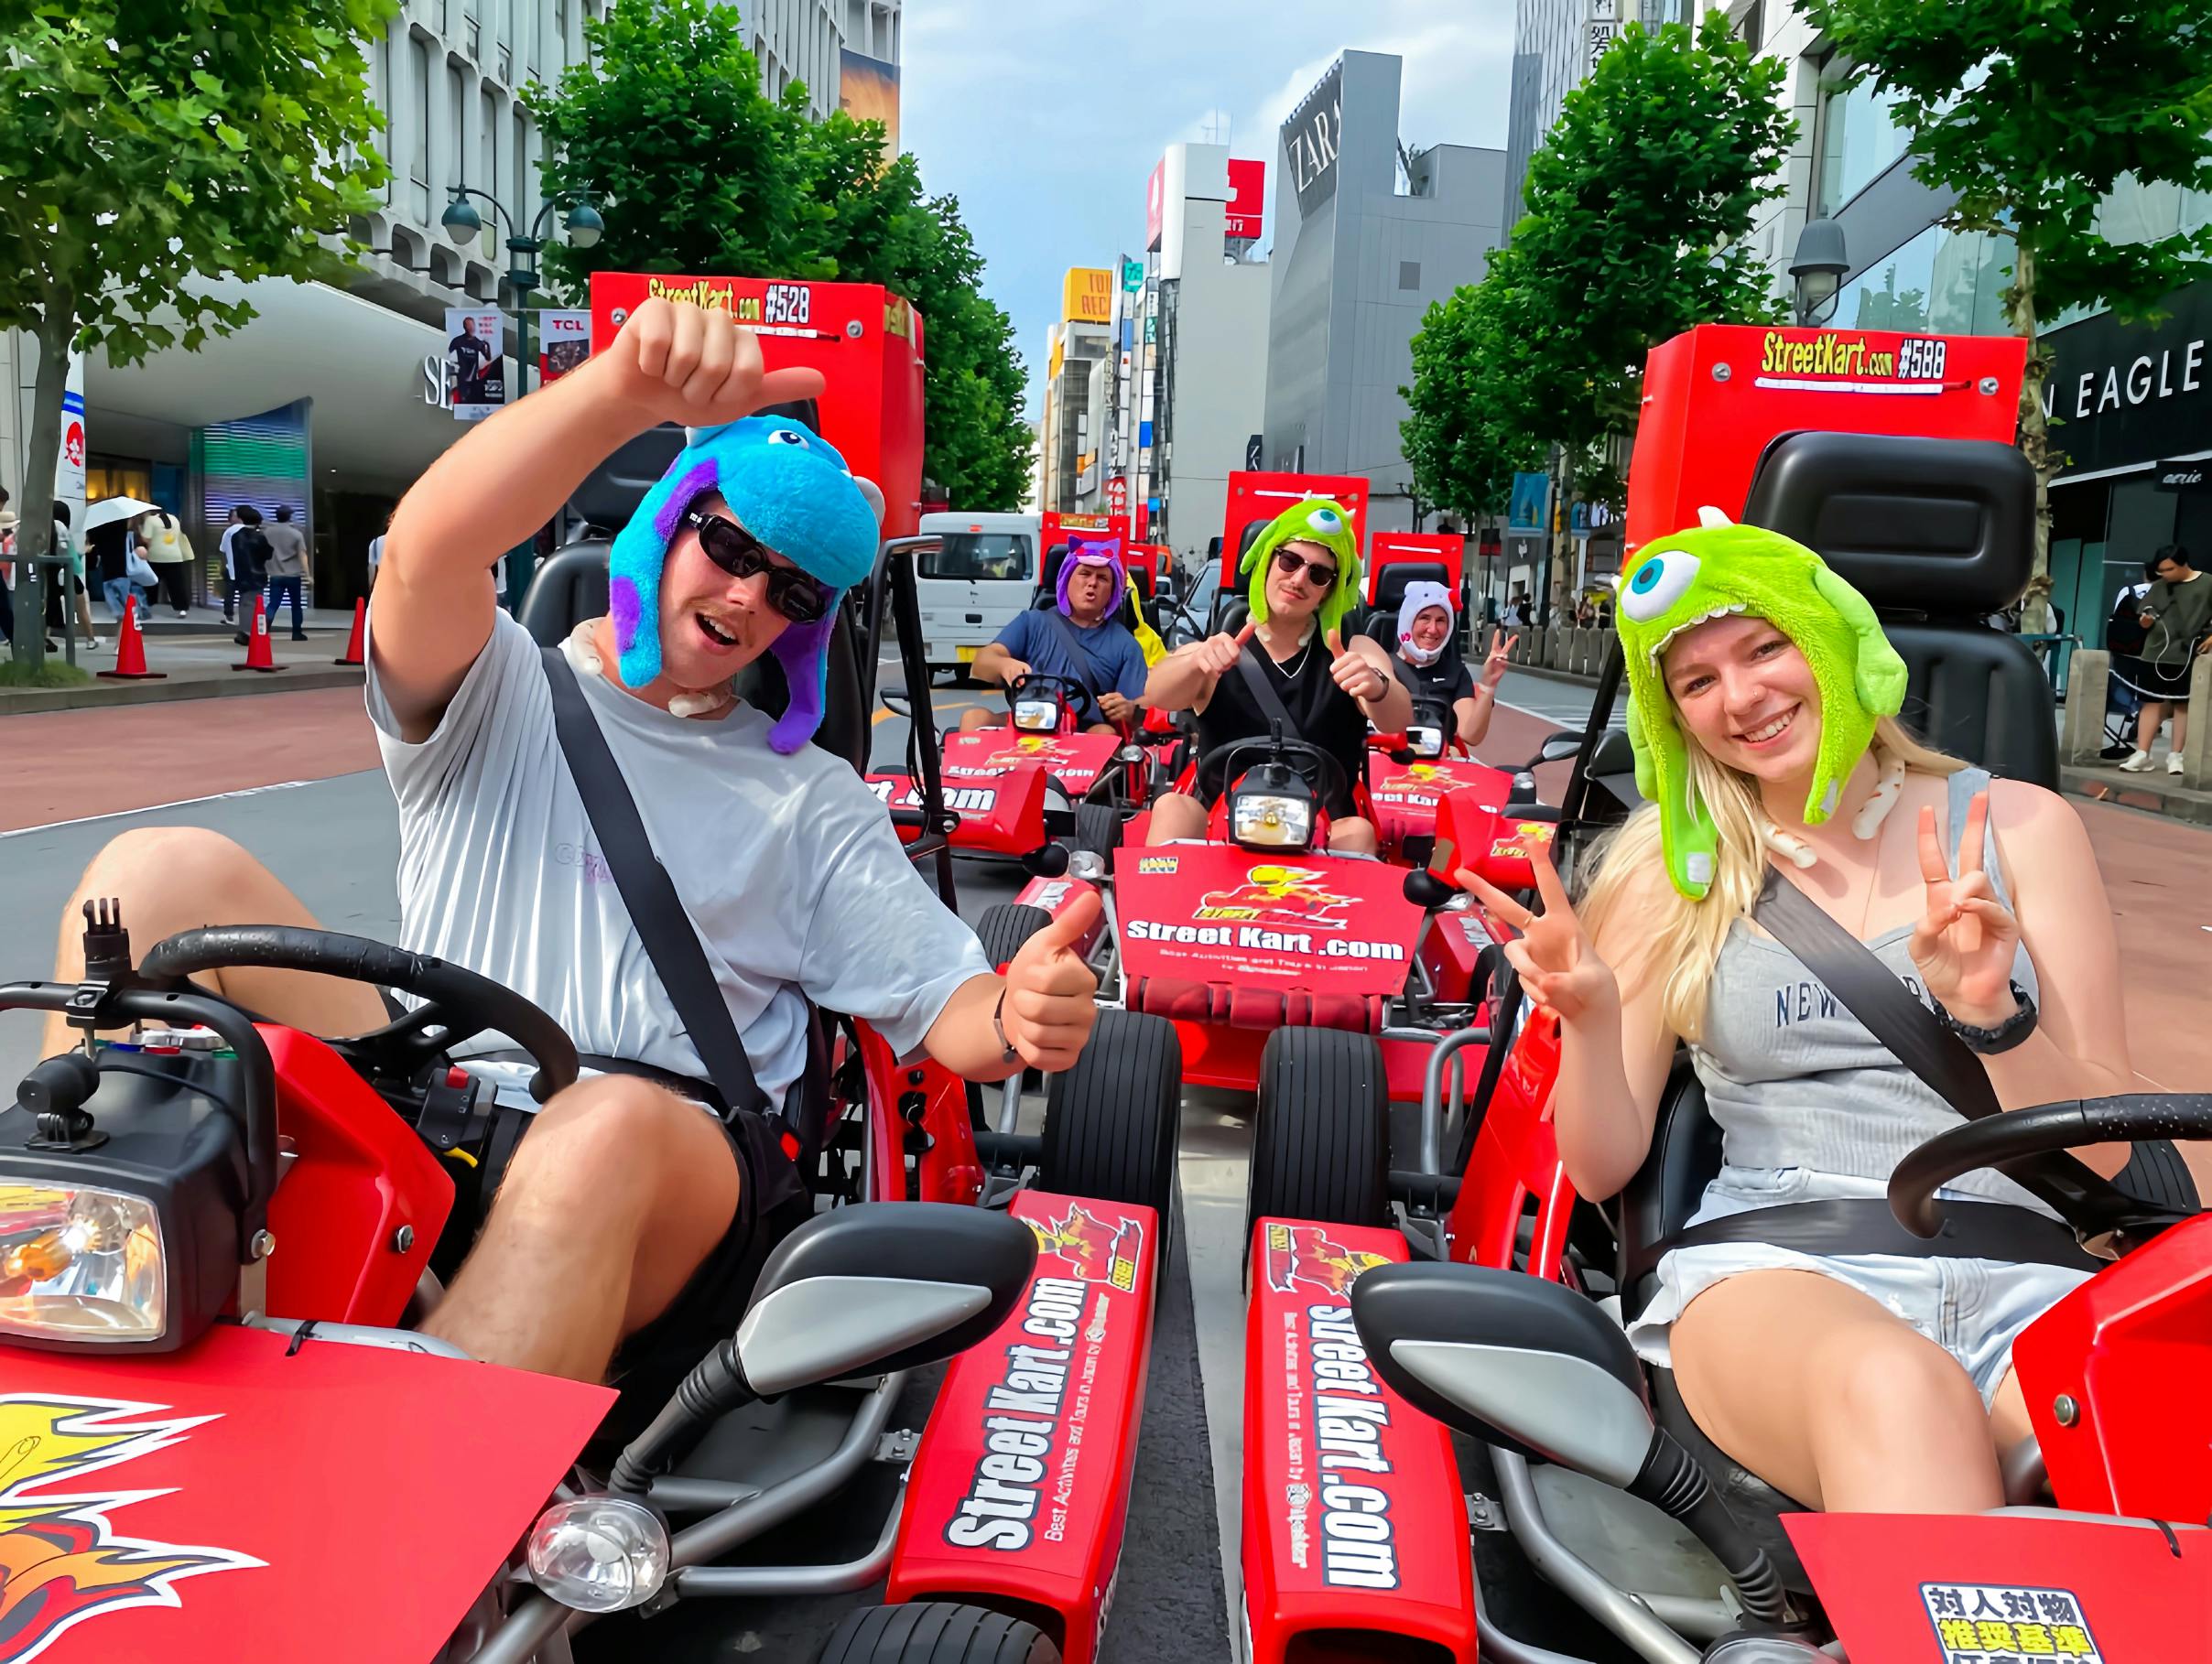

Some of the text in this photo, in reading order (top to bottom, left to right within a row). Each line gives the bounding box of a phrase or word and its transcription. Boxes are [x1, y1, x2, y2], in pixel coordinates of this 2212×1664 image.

[765, 283, 810, 324] #528
[552, 319, 585, 331] TCL
[1762, 330, 1946, 379] StreetKart.com #588
[2076, 340, 2205, 418] EAGLE
[1126, 919, 1404, 960] Street Kart .com
[1776, 981, 1838, 1028] NEW
[947, 1277, 1087, 1551] Street Kart .com
[1068, 1424, 1084, 1445] and
[1309, 1305, 1398, 1589] Street Kart .com
[1052, 1447, 1079, 1507] Activities
[1044, 1507, 1068, 1542] Best
[1928, 1587, 2077, 1624] 対人対物
[1937, 1617, 2096, 1659] 推奨基準
